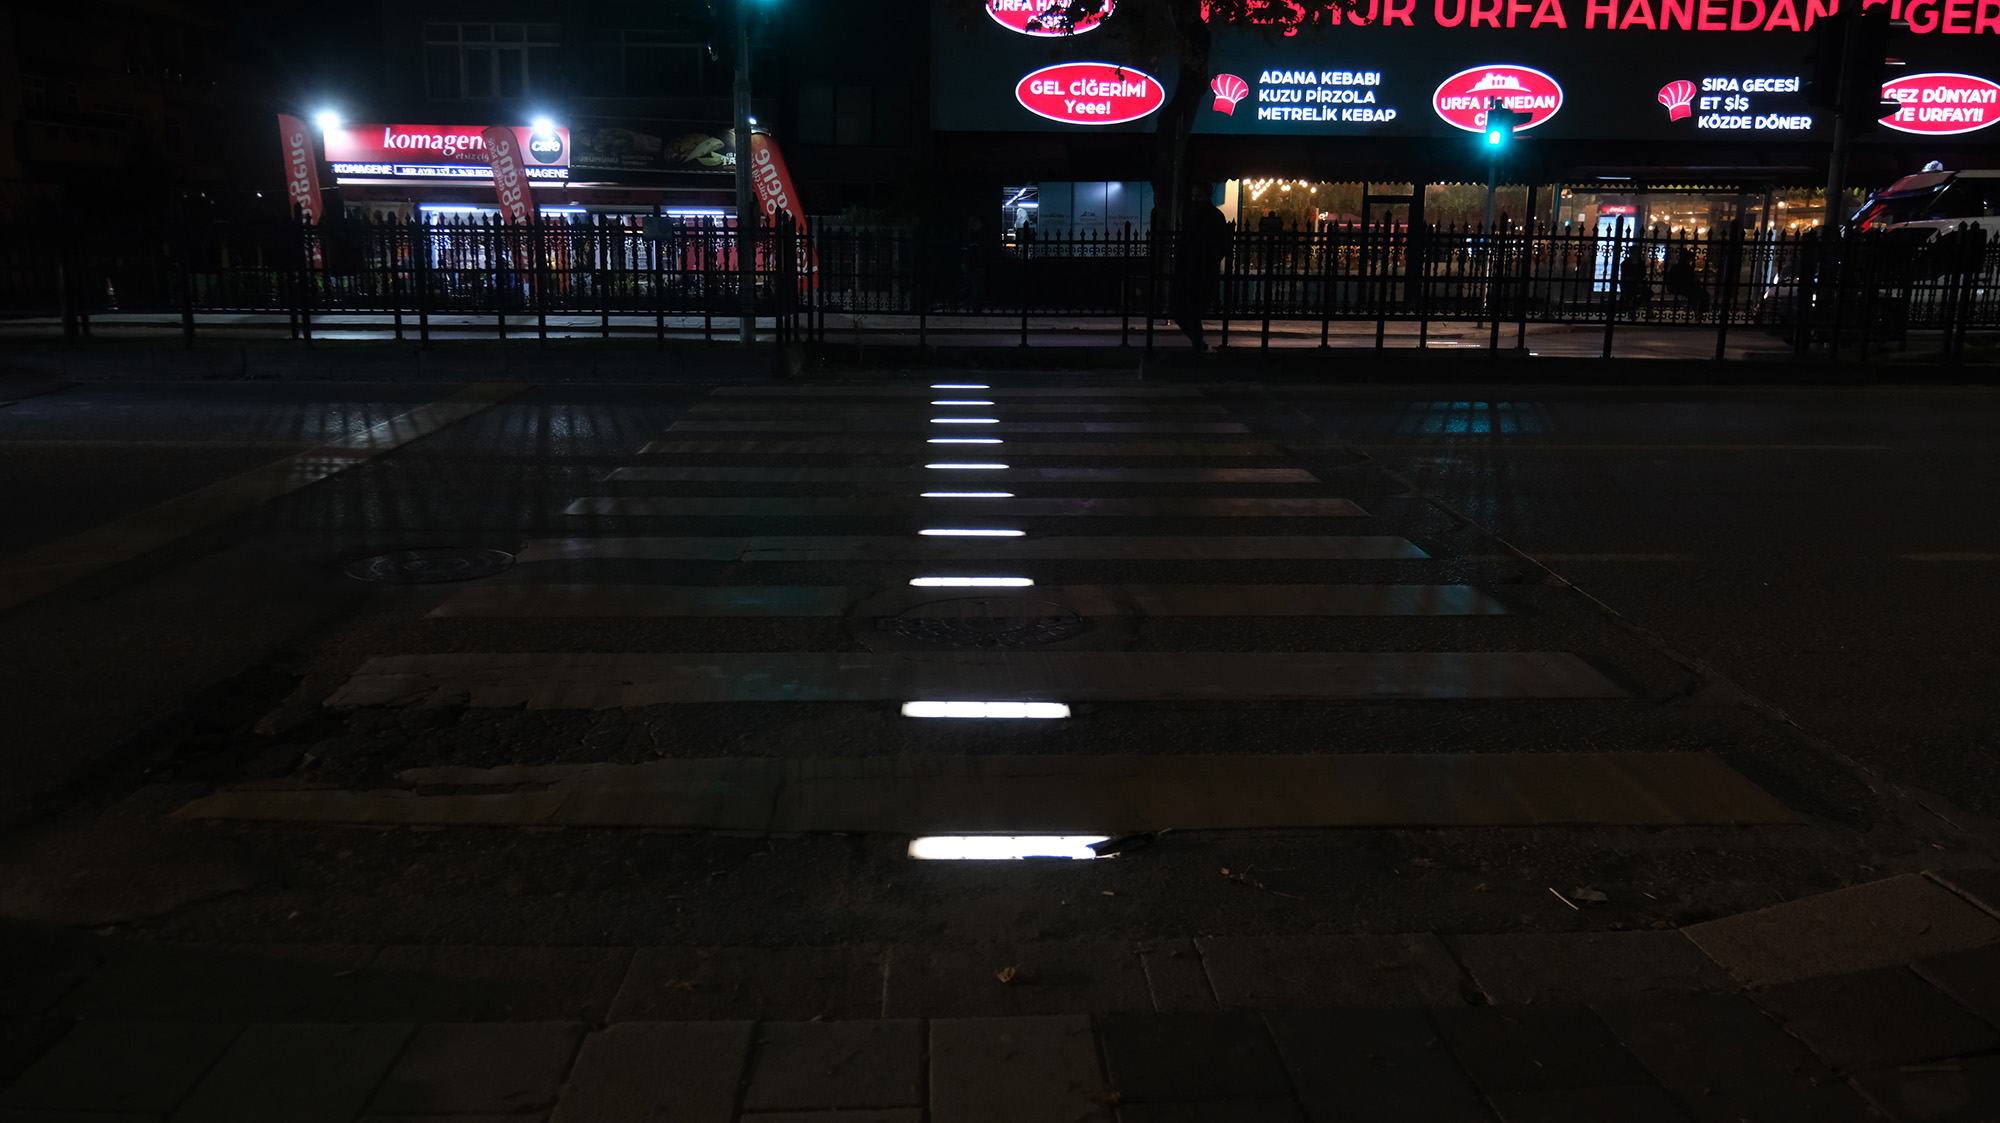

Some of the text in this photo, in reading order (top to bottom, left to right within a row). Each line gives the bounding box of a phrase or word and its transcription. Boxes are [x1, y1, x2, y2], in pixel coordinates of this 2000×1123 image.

[1434, 0, 1568, 29] URFA
[1259, 71, 1381, 86] ADANA KEBABI
[1702, 77, 1800, 92] SIRA GECESİ
[1030, 79, 1146, 98] GEL CİĞERİMİ
[1259, 87, 1376, 104] KUZU PİRZOLA
[1884, 87, 1996, 104] GEZ DÜNYAYI
[1064, 100, 1111, 114] Yeee!
[1441, 97, 1480, 110] URFA
[1700, 94, 1749, 112] ET ŞİŞ
[1258, 105, 1396, 122] METRELİK KEBAP
[1919, 108, 1983, 122] URFAYI!
[1698, 114, 1812, 130] KÖZDE DÖNER
[383, 127, 487, 156] komagen
[333, 163, 393, 174] KOMAGENE
